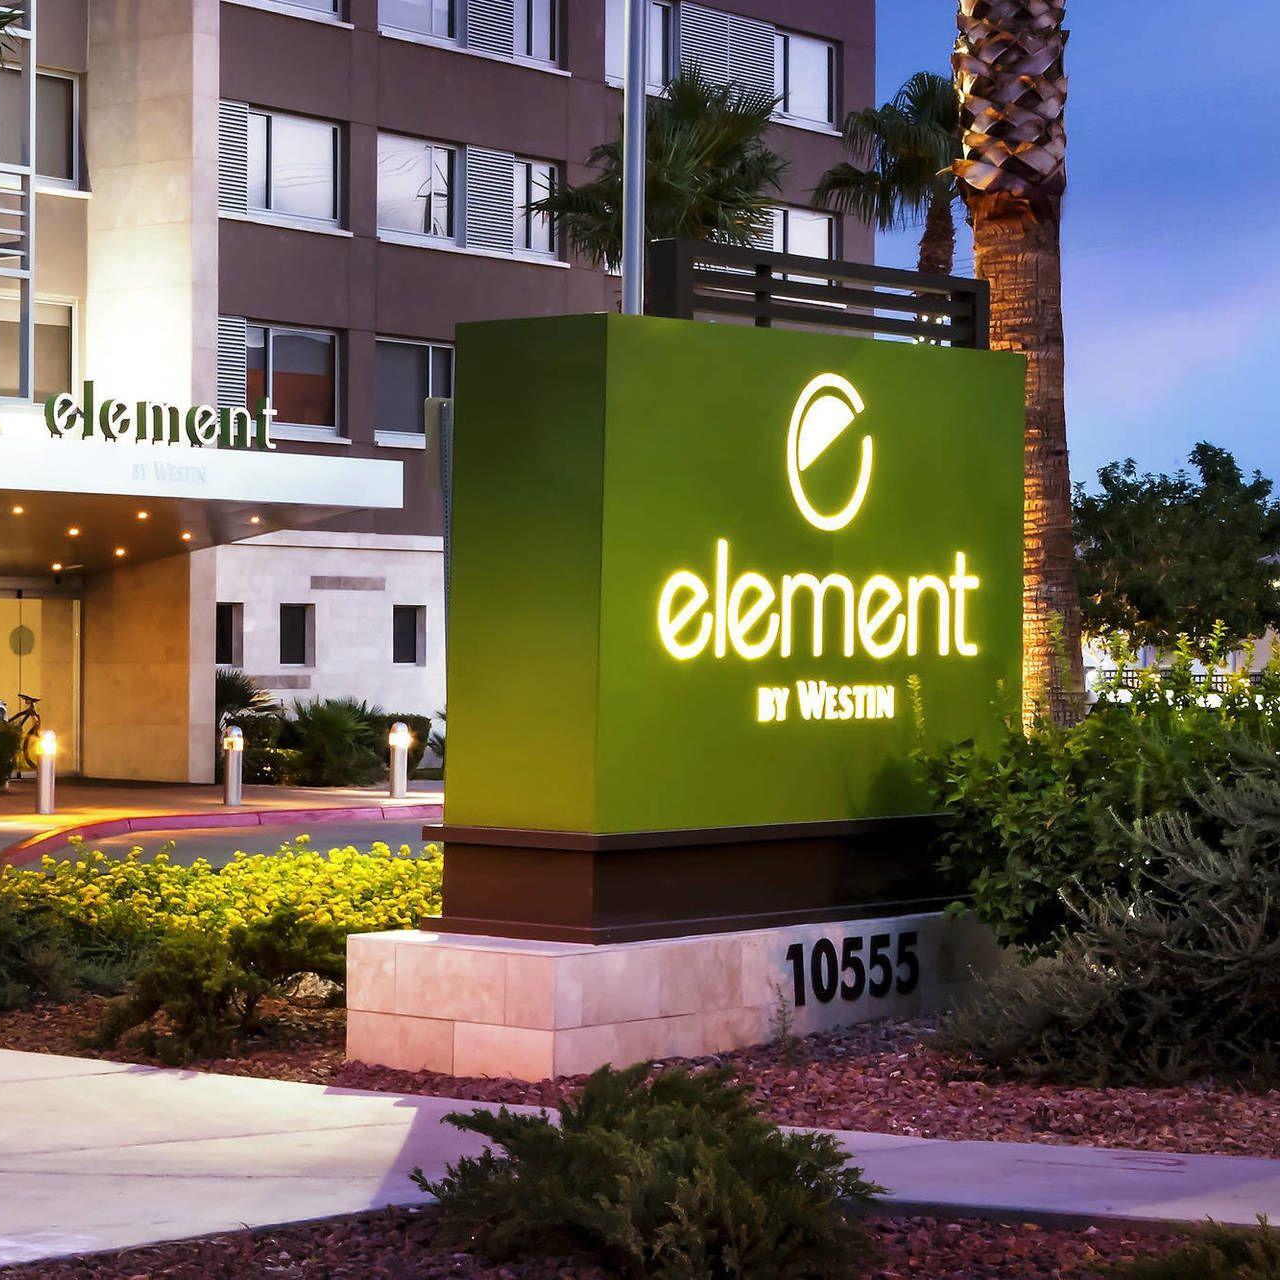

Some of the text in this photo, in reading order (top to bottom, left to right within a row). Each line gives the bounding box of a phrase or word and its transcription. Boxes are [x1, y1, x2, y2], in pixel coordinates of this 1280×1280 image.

[45, 380, 278, 449] element
[657, 538, 981, 662] element
[757, 686, 790, 723] BY
[786, 931, 920, 1007] 10555
